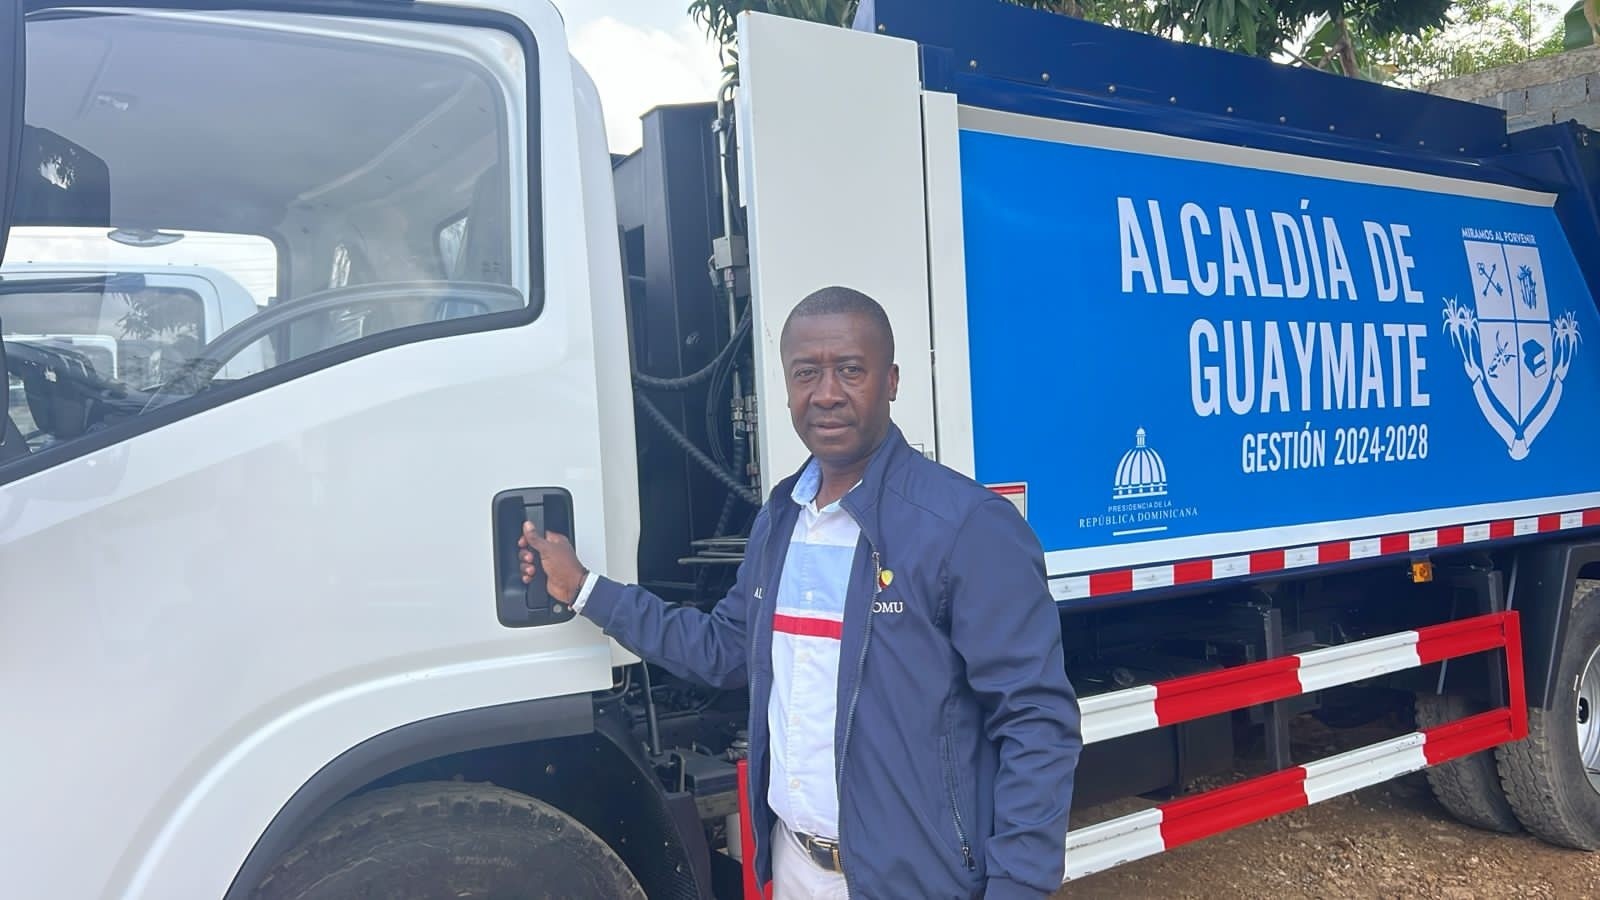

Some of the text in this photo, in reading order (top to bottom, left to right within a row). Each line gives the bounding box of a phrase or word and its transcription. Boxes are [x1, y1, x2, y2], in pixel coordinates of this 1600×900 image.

[1116, 197, 1425, 304] ALCALDÍA DE
[1462, 227, 1537, 244] MIRAMOS AL PORVENIR
[1188, 318, 1431, 417] GUAYMATE
[1242, 421, 1429, 474] GESTIÓN 2024-2028
[1079, 507, 1199, 529] REPÚBLICA DOMINICANA
[1107, 501, 1153, 513] PRESIDENCIA
[1153, 500, 1164, 508] DE
